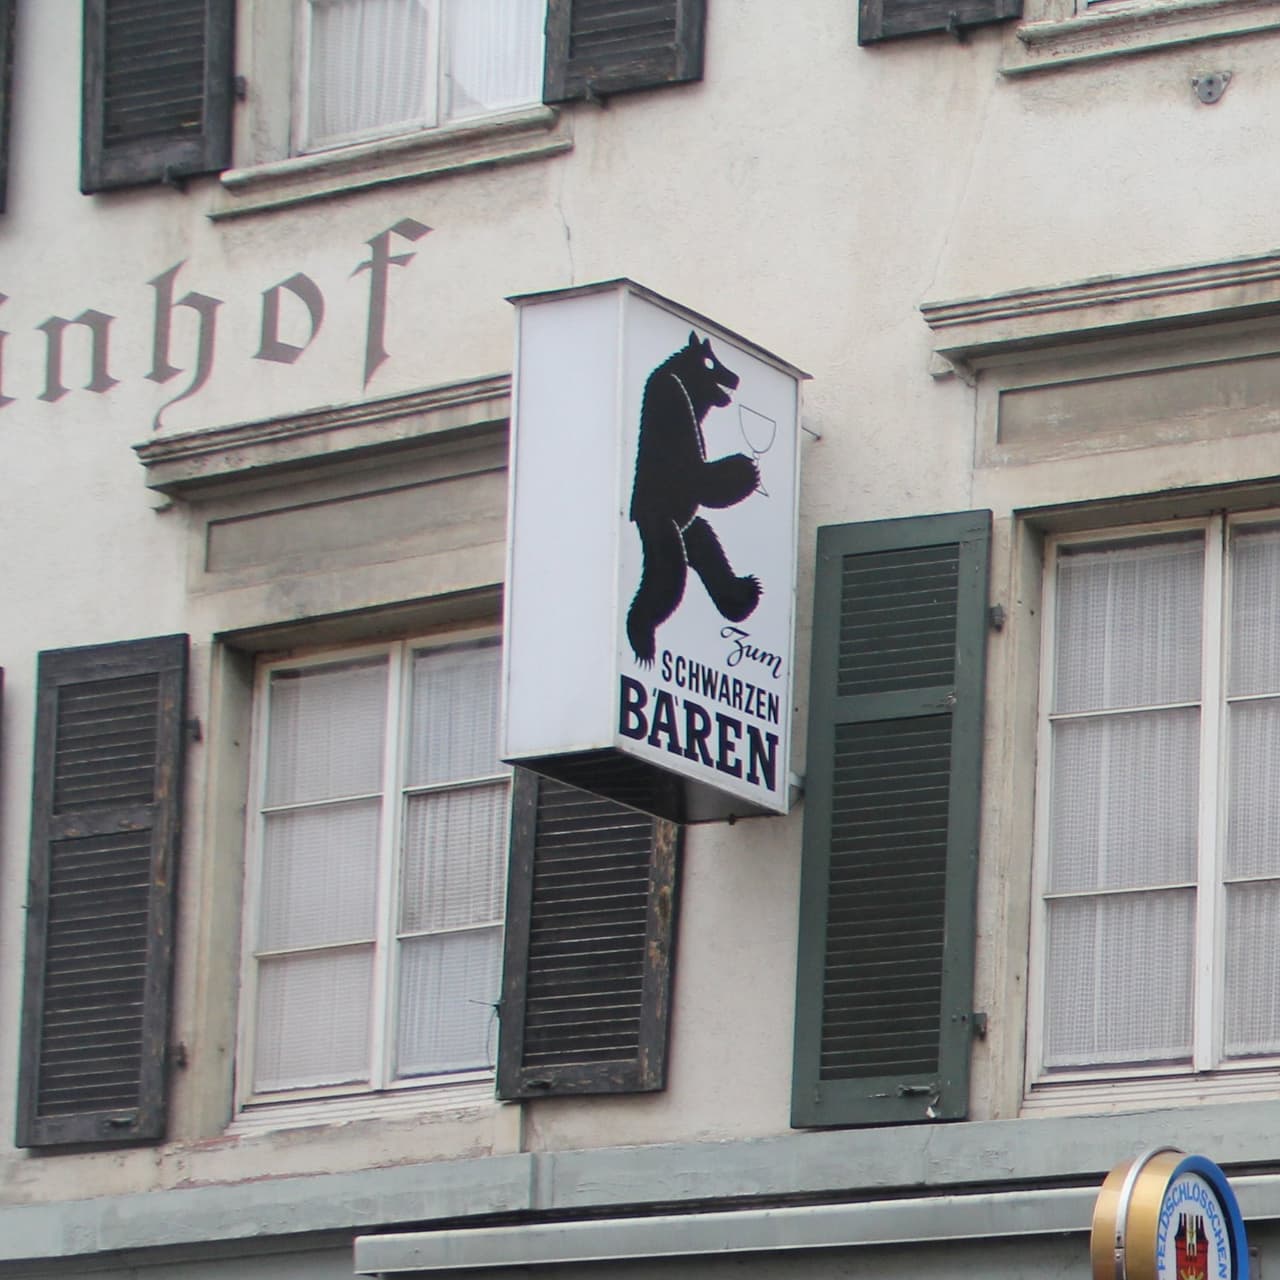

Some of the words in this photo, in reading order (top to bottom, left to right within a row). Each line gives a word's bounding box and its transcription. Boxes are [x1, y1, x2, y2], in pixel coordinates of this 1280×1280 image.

[661, 650, 780, 725] SCHWARZEN
[720, 626, 783, 680] Zum
[619, 674, 780, 792] BÄREN
